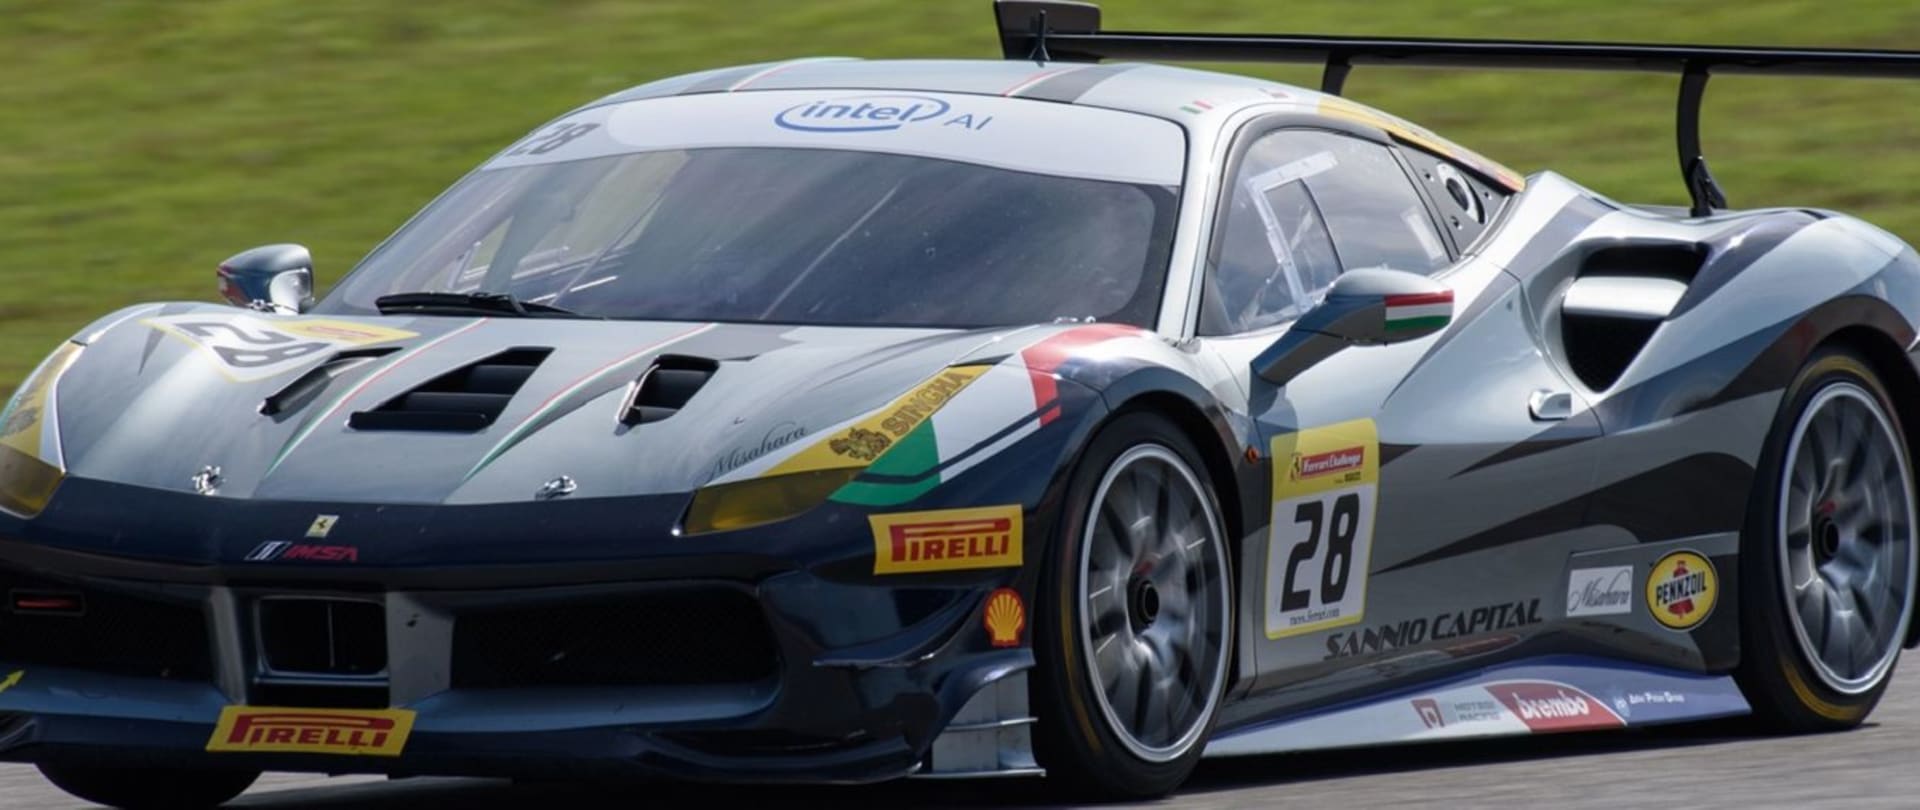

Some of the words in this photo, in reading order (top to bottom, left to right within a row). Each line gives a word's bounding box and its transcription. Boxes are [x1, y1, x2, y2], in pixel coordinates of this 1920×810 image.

[800, 101, 923, 121] intel
[944, 113, 993, 130] AI
[173, 322, 334, 368] 28
[881, 372, 974, 437] SINGHA
[282, 544, 359, 562] IMSA
[889, 518, 1012, 563] PIRELLI
[1280, 492, 1360, 613] 28
[1655, 571, 1707, 607] PENNZOIL
[1323, 617, 1428, 660] SANNIO
[1430, 598, 1543, 641] CAPITAL
[1512, 690, 1590, 720] brembo
[227, 713, 395, 747] PIRELLI
